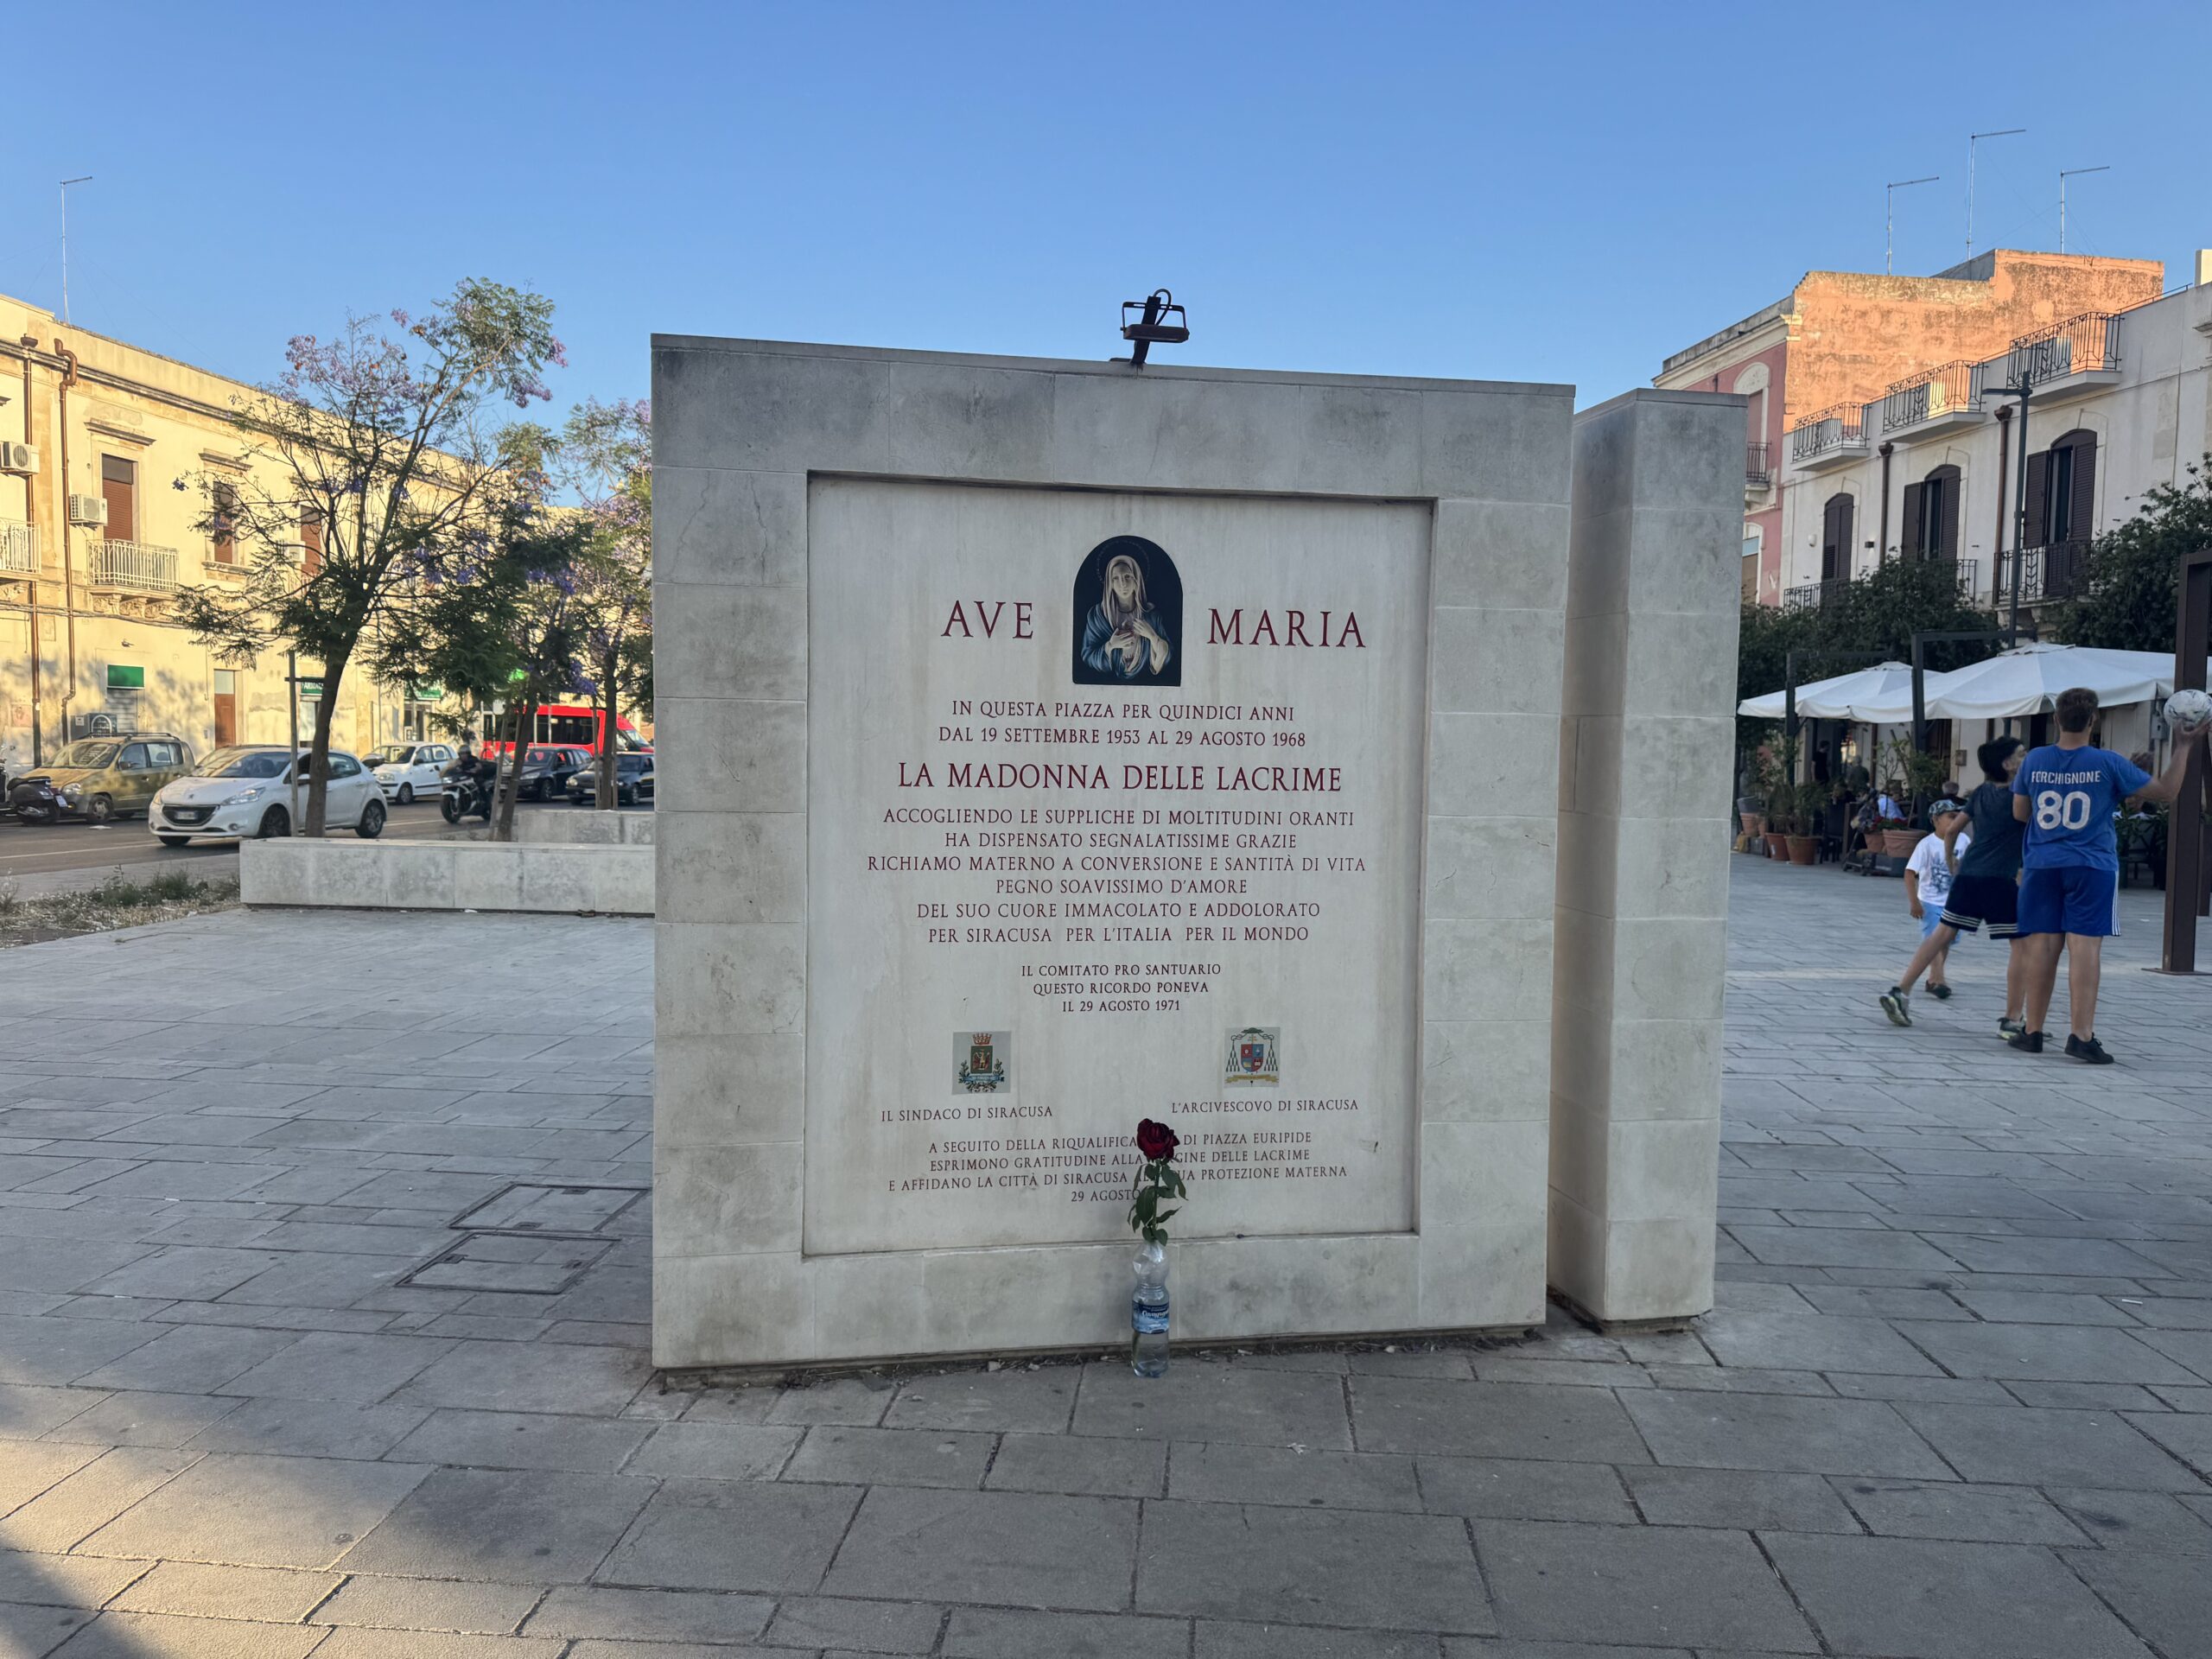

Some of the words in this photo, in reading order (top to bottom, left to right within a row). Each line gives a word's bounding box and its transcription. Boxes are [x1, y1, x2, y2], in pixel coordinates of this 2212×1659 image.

[941, 600, 1033, 639] AVE
[1207, 608, 1366, 648] MARIA
[952, 701, 972, 715] IN
[981, 701, 1046, 718] QUESTA
[1055, 702, 1115, 718] PIAZZA
[1122, 704, 1152, 719] PER
[1160, 705, 1242, 721] QUINDICI
[1249, 707, 1294, 721] ANNI
[939, 727, 973, 741] DAL
[982, 728, 997, 741] 19
[1005, 728, 1099, 743] SETTEMBRE
[1107, 730, 1140, 744] 1953
[1147, 731, 1168, 745] AL
[1175, 731, 1192, 745] 29
[1199, 731, 1265, 746] AGOSTO
[1273, 733, 1306, 747] 1968
[899, 762, 935, 787] LA
[947, 763, 1110, 789] MADONNA
[1122, 766, 1204, 790] DELLE
[1217, 766, 1341, 791] LACRIME
[2031, 771, 2101, 785] FORCHIGNONE
[883, 809, 1012, 823] ACCOGLIENDO
[1020, 810, 1038, 823] LE
[1046, 810, 1135, 823] SUPPLICHE
[1142, 810, 1160, 824] DI
[1168, 810, 1281, 825] MOLTITUDINI
[1290, 811, 1353, 825] ORANTI
[2037, 790, 2091, 830] 80
[945, 833, 970, 847] HA
[979, 833, 1082, 847] DISPENSATO
[1090, 834, 1229, 848] SEGNALATISSIME
[1236, 834, 1296, 848] GRAZIE
[868, 856, 961, 870] RICHIAMO
[969, 856, 1054, 870] MATERNO
[1062, 857, 1073, 870] A
[1081, 856, 1202, 870] CONVERSIONE
[1210, 857, 1217, 870] E
[1225, 854, 1294, 871] SANTITÀ
[1302, 858, 1319, 871] DI
[1327, 858, 1365, 871] VITA
[996, 880, 1052, 893] PEGNO
[1060, 880, 1162, 893] SOAVISSIMO
[1171, 880, 1247, 893] D'AMORE
[917, 904, 948, 918] DEL
[957, 904, 990, 918] SUO
[998, 904, 1057, 918] CUORE
[1065, 903, 1181, 917] IMMACOLATO
[1190, 903, 1197, 917] E
[1204, 903, 1319, 917] ADDOLORATO
[929, 929, 959, 943] PER
[967, 928, 1052, 942] SIRACUSA
[1066, 928, 1096, 942] PER
[1103, 927, 1172, 941] L'ITALIA
[1186, 927, 1214, 941] PER
[1223, 927, 1236, 940] IL
[1244, 927, 1308, 940] MONDO
[1022, 966, 1033, 976] IL
[1039, 965, 1109, 976] COMITATO
[1115, 964, 1140, 976] PRO
[1146, 964, 1220, 975] SANTUARIO
[1033, 983, 1084, 996] QUESTO
[1090, 982, 1151, 994] RICORDO
[1157, 982, 1208, 993] PONEVA
[1063, 1001, 1074, 1012] IL
[1080, 1001, 1093, 1012] 29
[1099, 1001, 1149, 1011] AGOSTO
[1156, 1000, 1179, 1011] 1971
[882, 1110, 893, 1122] IL
[899, 1109, 961, 1121] SINDACO
[968, 1108, 981, 1119] DI
[988, 1106, 1052, 1118] SIRACUSA
[1173, 1101, 1272, 1113] L'ARCIVESCOVO
[1279, 1101, 1291, 1111] DI
[1297, 1099, 1357, 1110] SIRACUSA
[929, 1143, 938, 1154] A
[944, 1141, 1000, 1153] SEGUITO
[1007, 1139, 1046, 1150] DELLA
[1052, 1136, 1139, 1150] RIQUALIFICA
[1184, 1135, 1196, 1145] DI
[1204, 1134, 1247, 1145] PIAZZA
[1254, 1132, 1311, 1143] EURIPIDE
[931, 1158, 1008, 1171] ESPRIMONO
[1014, 1154, 1105, 1168] GRATITUDINE
[1111, 1154, 1143, 1165] ALLA
[1212, 1151, 1248, 1162] DELLE
[1255, 1149, 1309, 1160] LACRIME
[889, 1180, 894, 1192] E
[901, 1178, 971, 1191] AFFIDANO
[978, 1177, 993, 1187] LA
[999, 1173, 1039, 1186] CITTÀ
[1045, 1174, 1057, 1185] DI
[1064, 1173, 1127, 1185] SIRACUSA
[1178, 1169, 1196, 1181] UA
[1202, 1167, 1279, 1179] PROTEZIONE
[1286, 1166, 1347, 1178] MATERNA
[1071, 1191, 1084, 1202] 29
[1090, 1189, 1141, 1201] AGOSTO
